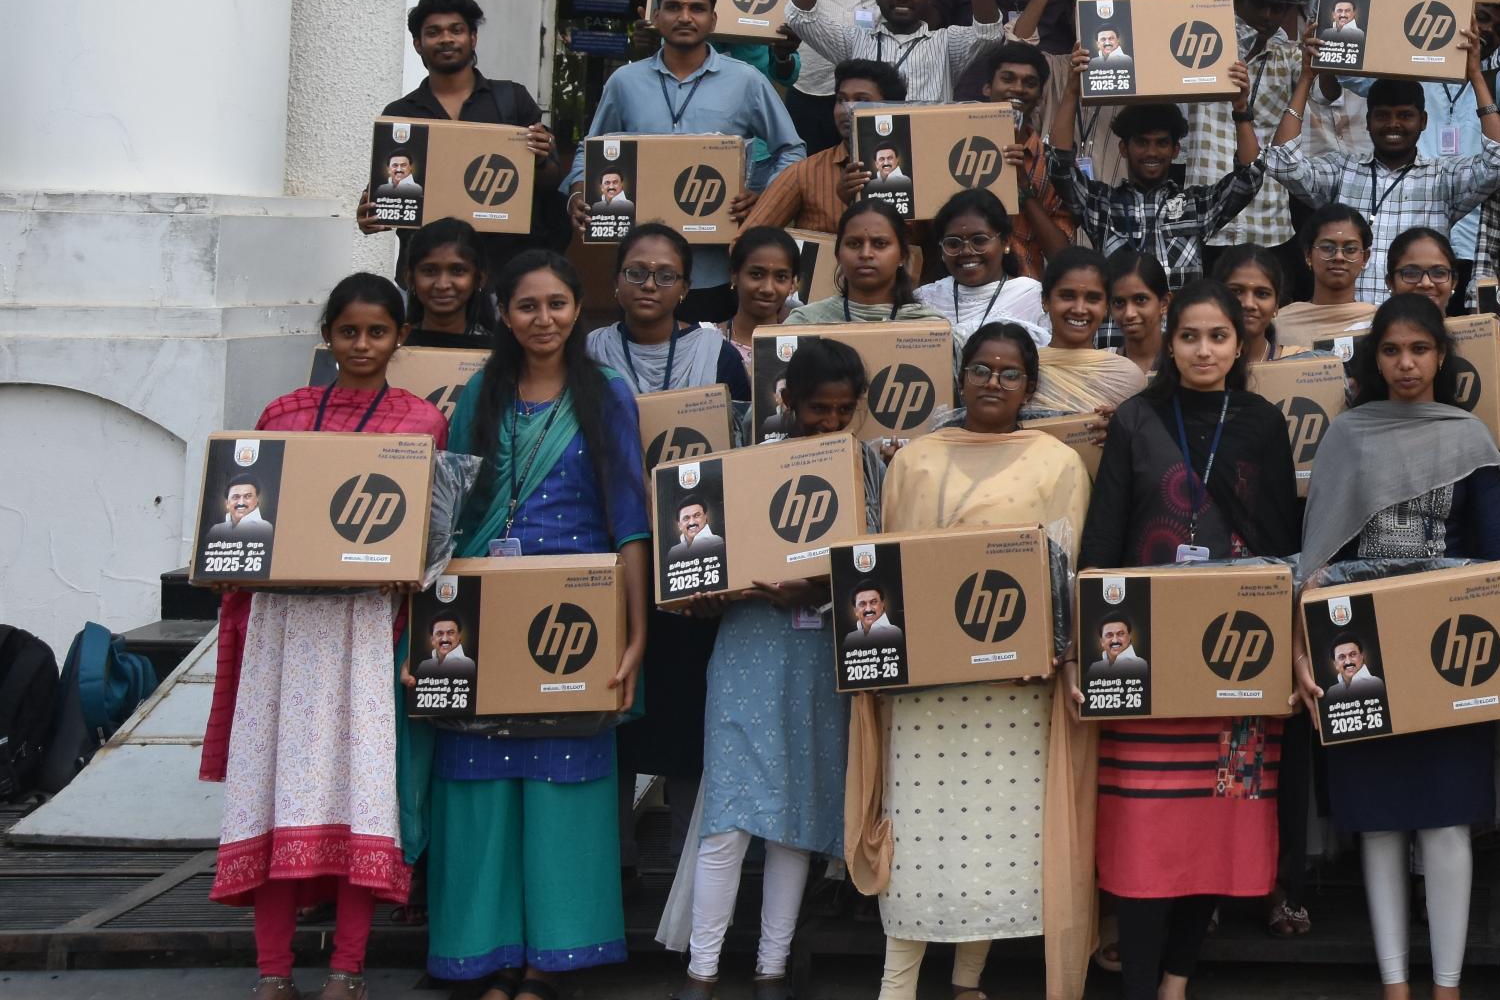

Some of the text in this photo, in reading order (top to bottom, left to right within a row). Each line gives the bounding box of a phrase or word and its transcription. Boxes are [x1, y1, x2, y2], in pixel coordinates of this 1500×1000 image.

[1177, 20, 1217, 69] hp
[1408, 0, 1453, 51] hp
[1319, 50, 1358, 65] 2025-26
[1090, 79, 1130, 91] 2025-26
[469, 153, 515, 206] hp
[955, 136, 998, 188] hp
[375, 207, 417, 222] 2025-26
[679, 164, 722, 217] hp
[874, 363, 930, 431] hp
[336, 473, 402, 544] hp
[777, 476, 833, 544] hp
[204, 556, 263, 573] 2025-26
[669, 568, 720, 593] 2025-26
[963, 569, 1020, 643] hp
[535, 603, 592, 675] hp
[1210, 610, 1268, 682] hp
[1442, 614, 1494, 688] hp
[846, 662, 899, 682] 2025-26
[416, 691, 468, 710] 2025-26
[1089, 693, 1142, 709] 2025-26
[1330, 712, 1385, 735] 2025-26
